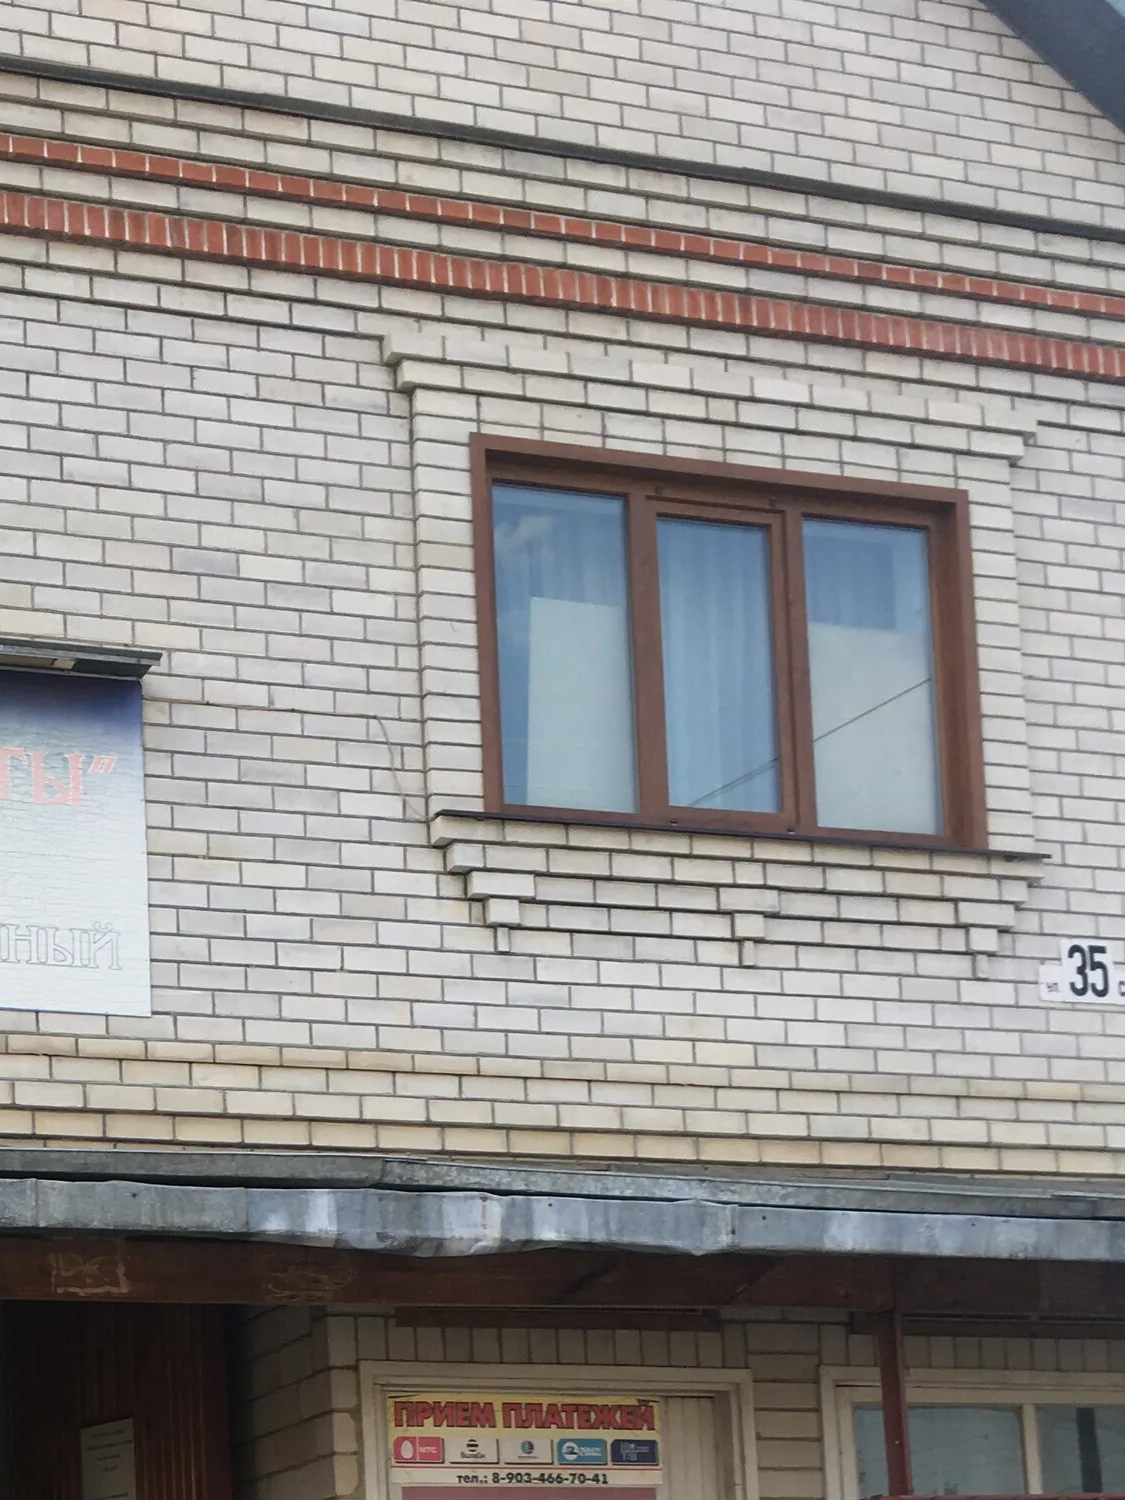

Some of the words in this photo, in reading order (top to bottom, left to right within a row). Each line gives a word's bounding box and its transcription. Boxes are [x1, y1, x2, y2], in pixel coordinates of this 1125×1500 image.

[1068, 944, 1109, 998] 35
[393, 1400, 497, 1429] ПРИЕМ
[502, 1398, 657, 1430] ПЛАТЕЖЕЙ
[457, 1473, 487, 1485] тел.:
[492, 1472, 608, 1485] 8-903-466-70-41
